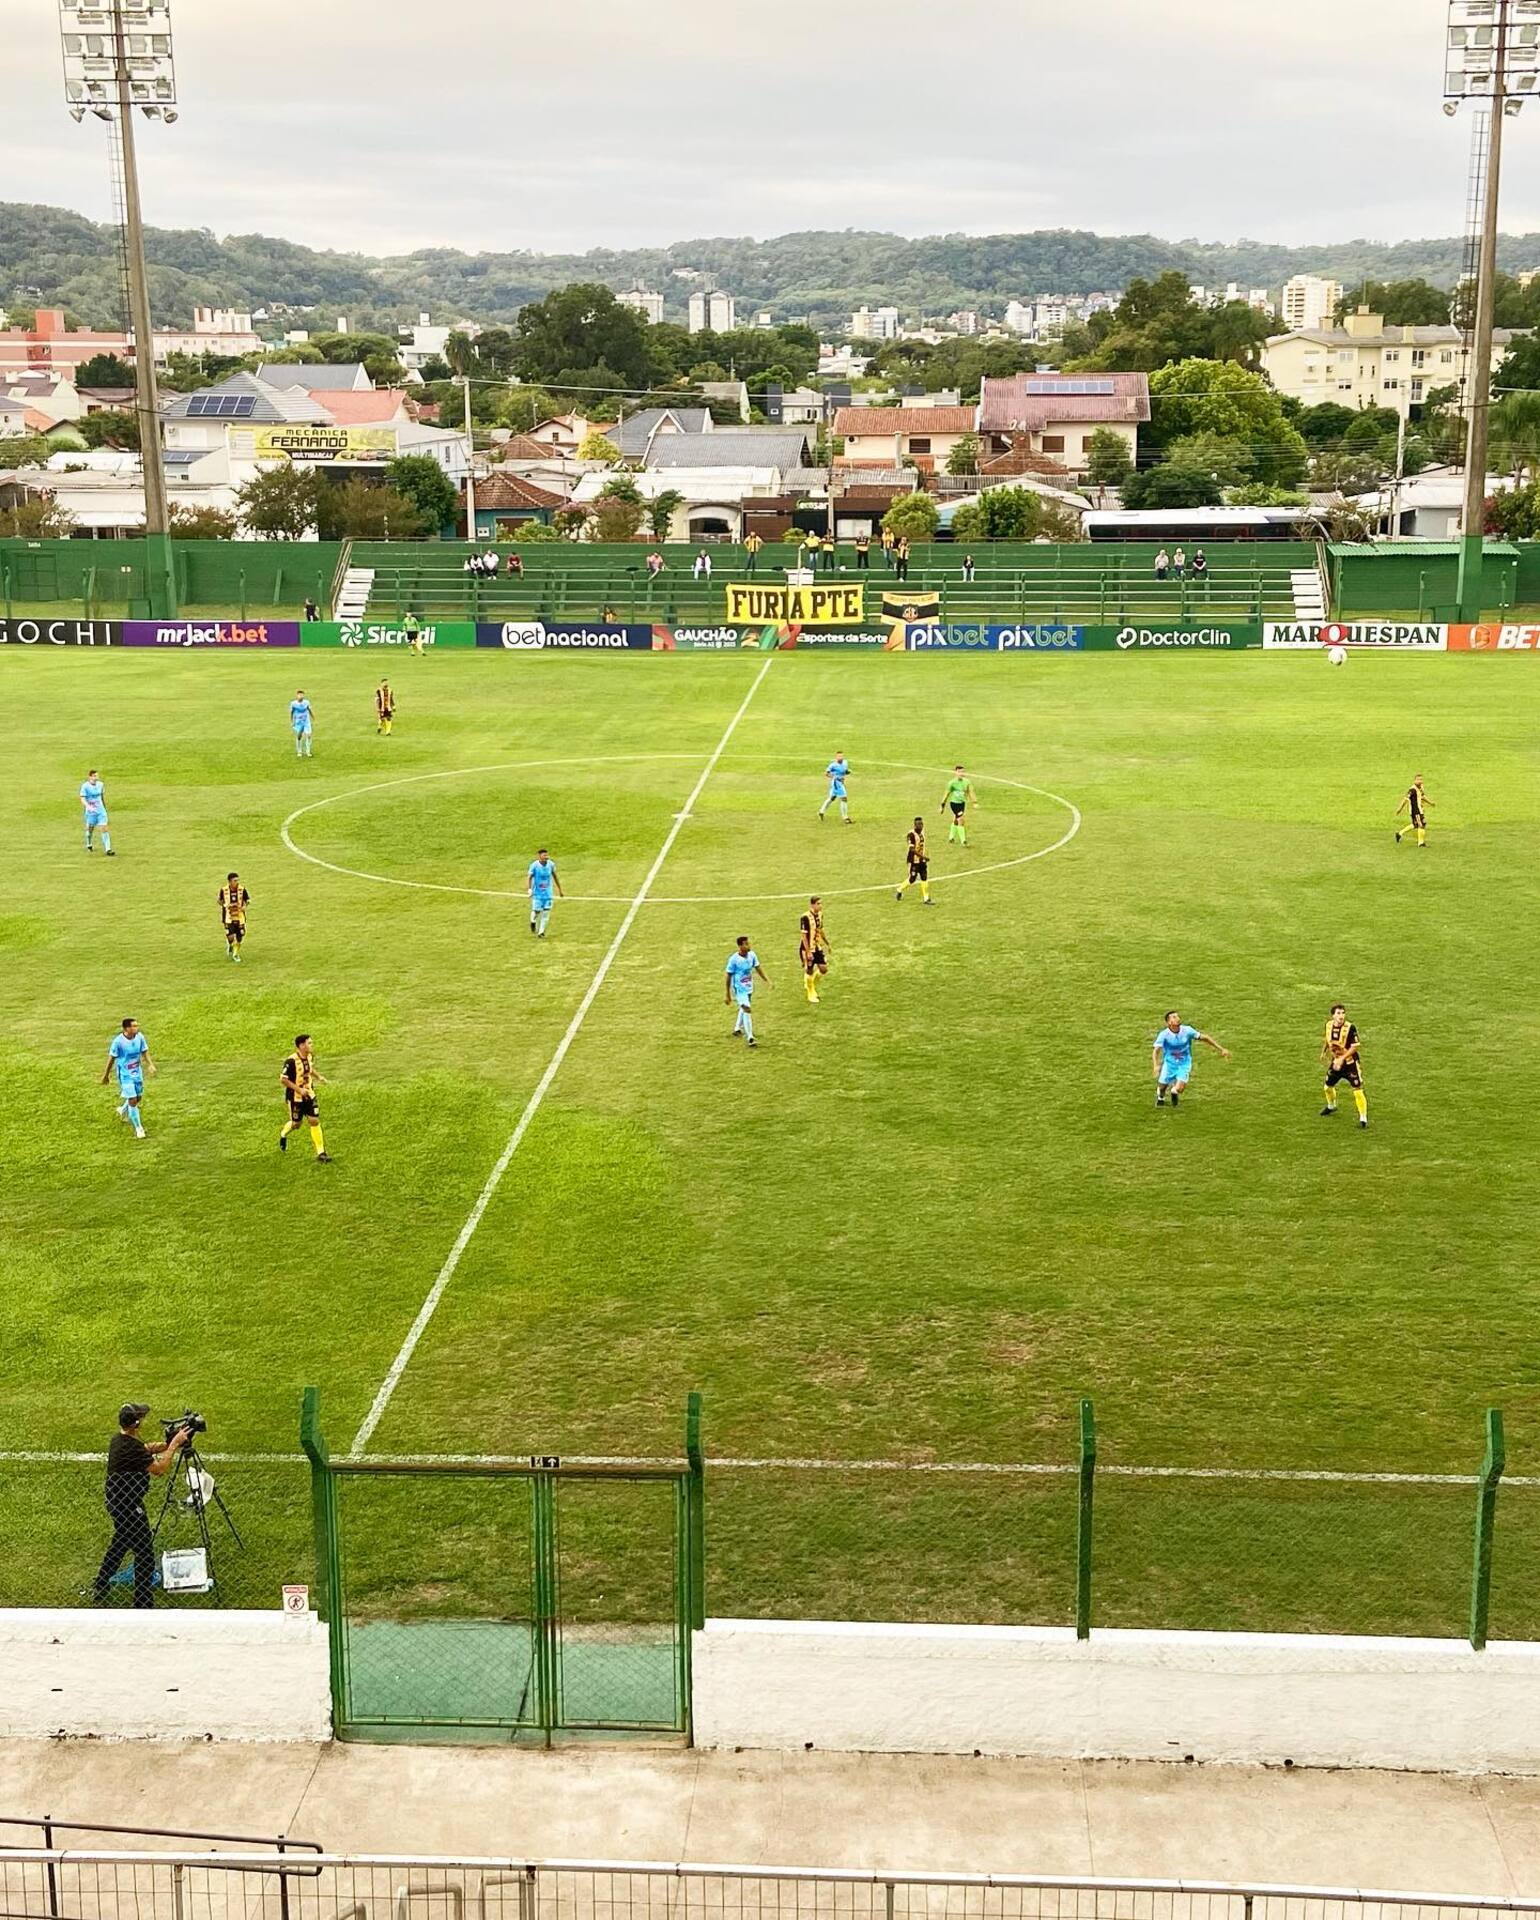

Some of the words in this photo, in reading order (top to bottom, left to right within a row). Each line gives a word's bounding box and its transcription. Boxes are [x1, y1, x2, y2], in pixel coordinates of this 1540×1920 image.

[271, 437, 348, 448] FERNANDO
[732, 589, 804, 619] FURIA
[811, 589, 859, 619] PTE
[367, 626, 436, 644] Sicrdi
[674, 627, 738, 641] GAUCHÃO
[859, 633, 888, 643] Sorte
[910, 624, 990, 651] pixbet
[998, 624, 1078, 651] pixbet
[1139, 628, 1231, 646] DoctorClin
[1272, 624, 1441, 645] MARQUESPAN
[1496, 625, 1540, 649] BE
